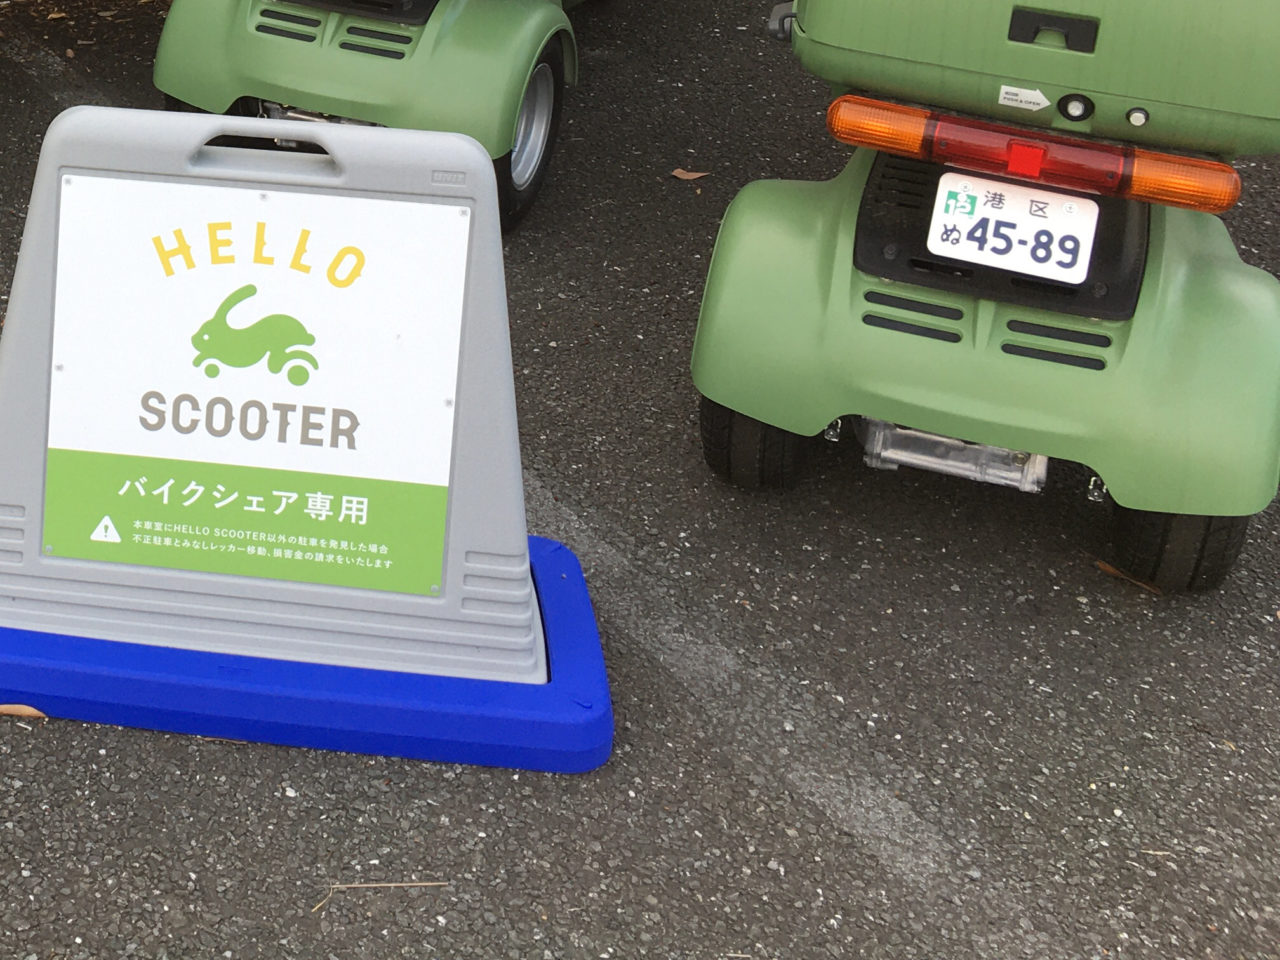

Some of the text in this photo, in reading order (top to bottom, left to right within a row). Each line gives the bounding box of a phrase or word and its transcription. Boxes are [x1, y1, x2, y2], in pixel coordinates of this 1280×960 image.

[152, 221, 366, 289] HELLO
[966, 217, 1081, 269] 45-89
[138, 390, 360, 451] SCOOTER
[118, 477, 369, 526] バイクシェア専用
